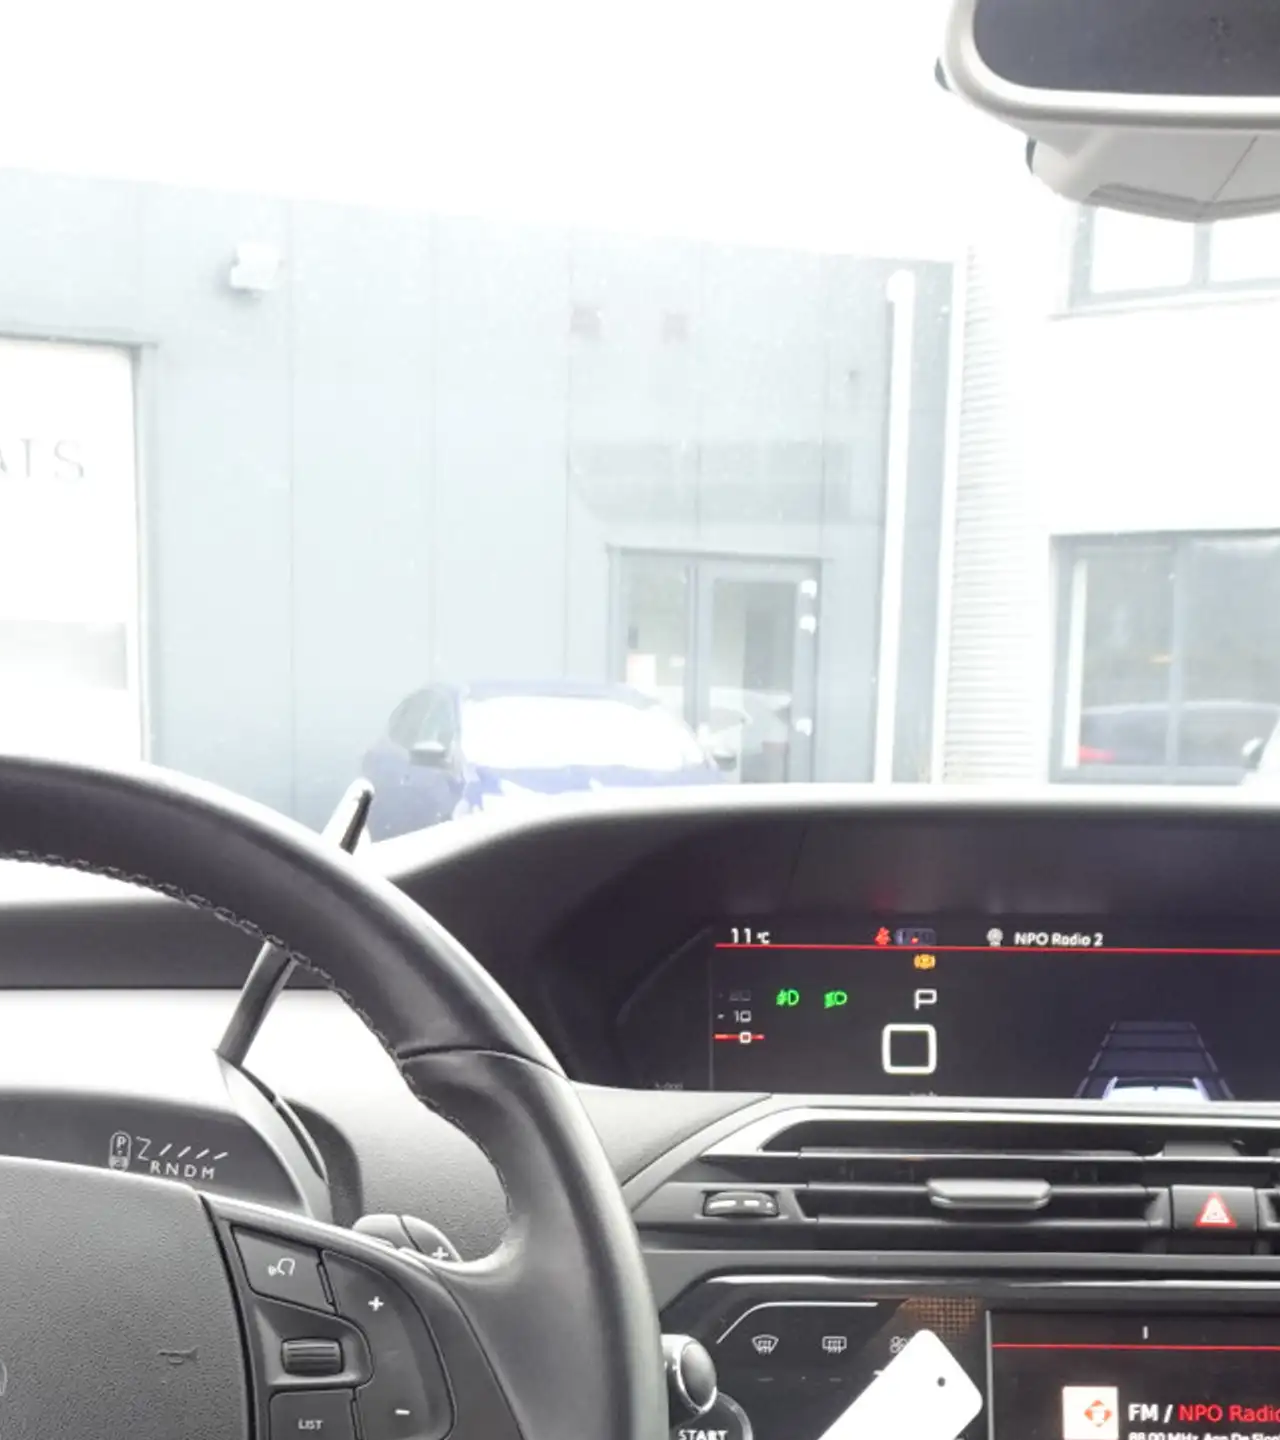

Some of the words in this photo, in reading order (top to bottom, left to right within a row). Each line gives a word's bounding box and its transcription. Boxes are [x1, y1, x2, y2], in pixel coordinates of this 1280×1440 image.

[1014, 931, 1049, 946] NPO
[1051, 932, 1091, 947] Radio
[1094, 932, 1104, 947] 2
[914, 988, 938, 1011] P
[1127, 1403, 1159, 1423] FM
[1177, 1404, 1223, 1423] NPO
[297, 1419, 323, 1430] LIST
